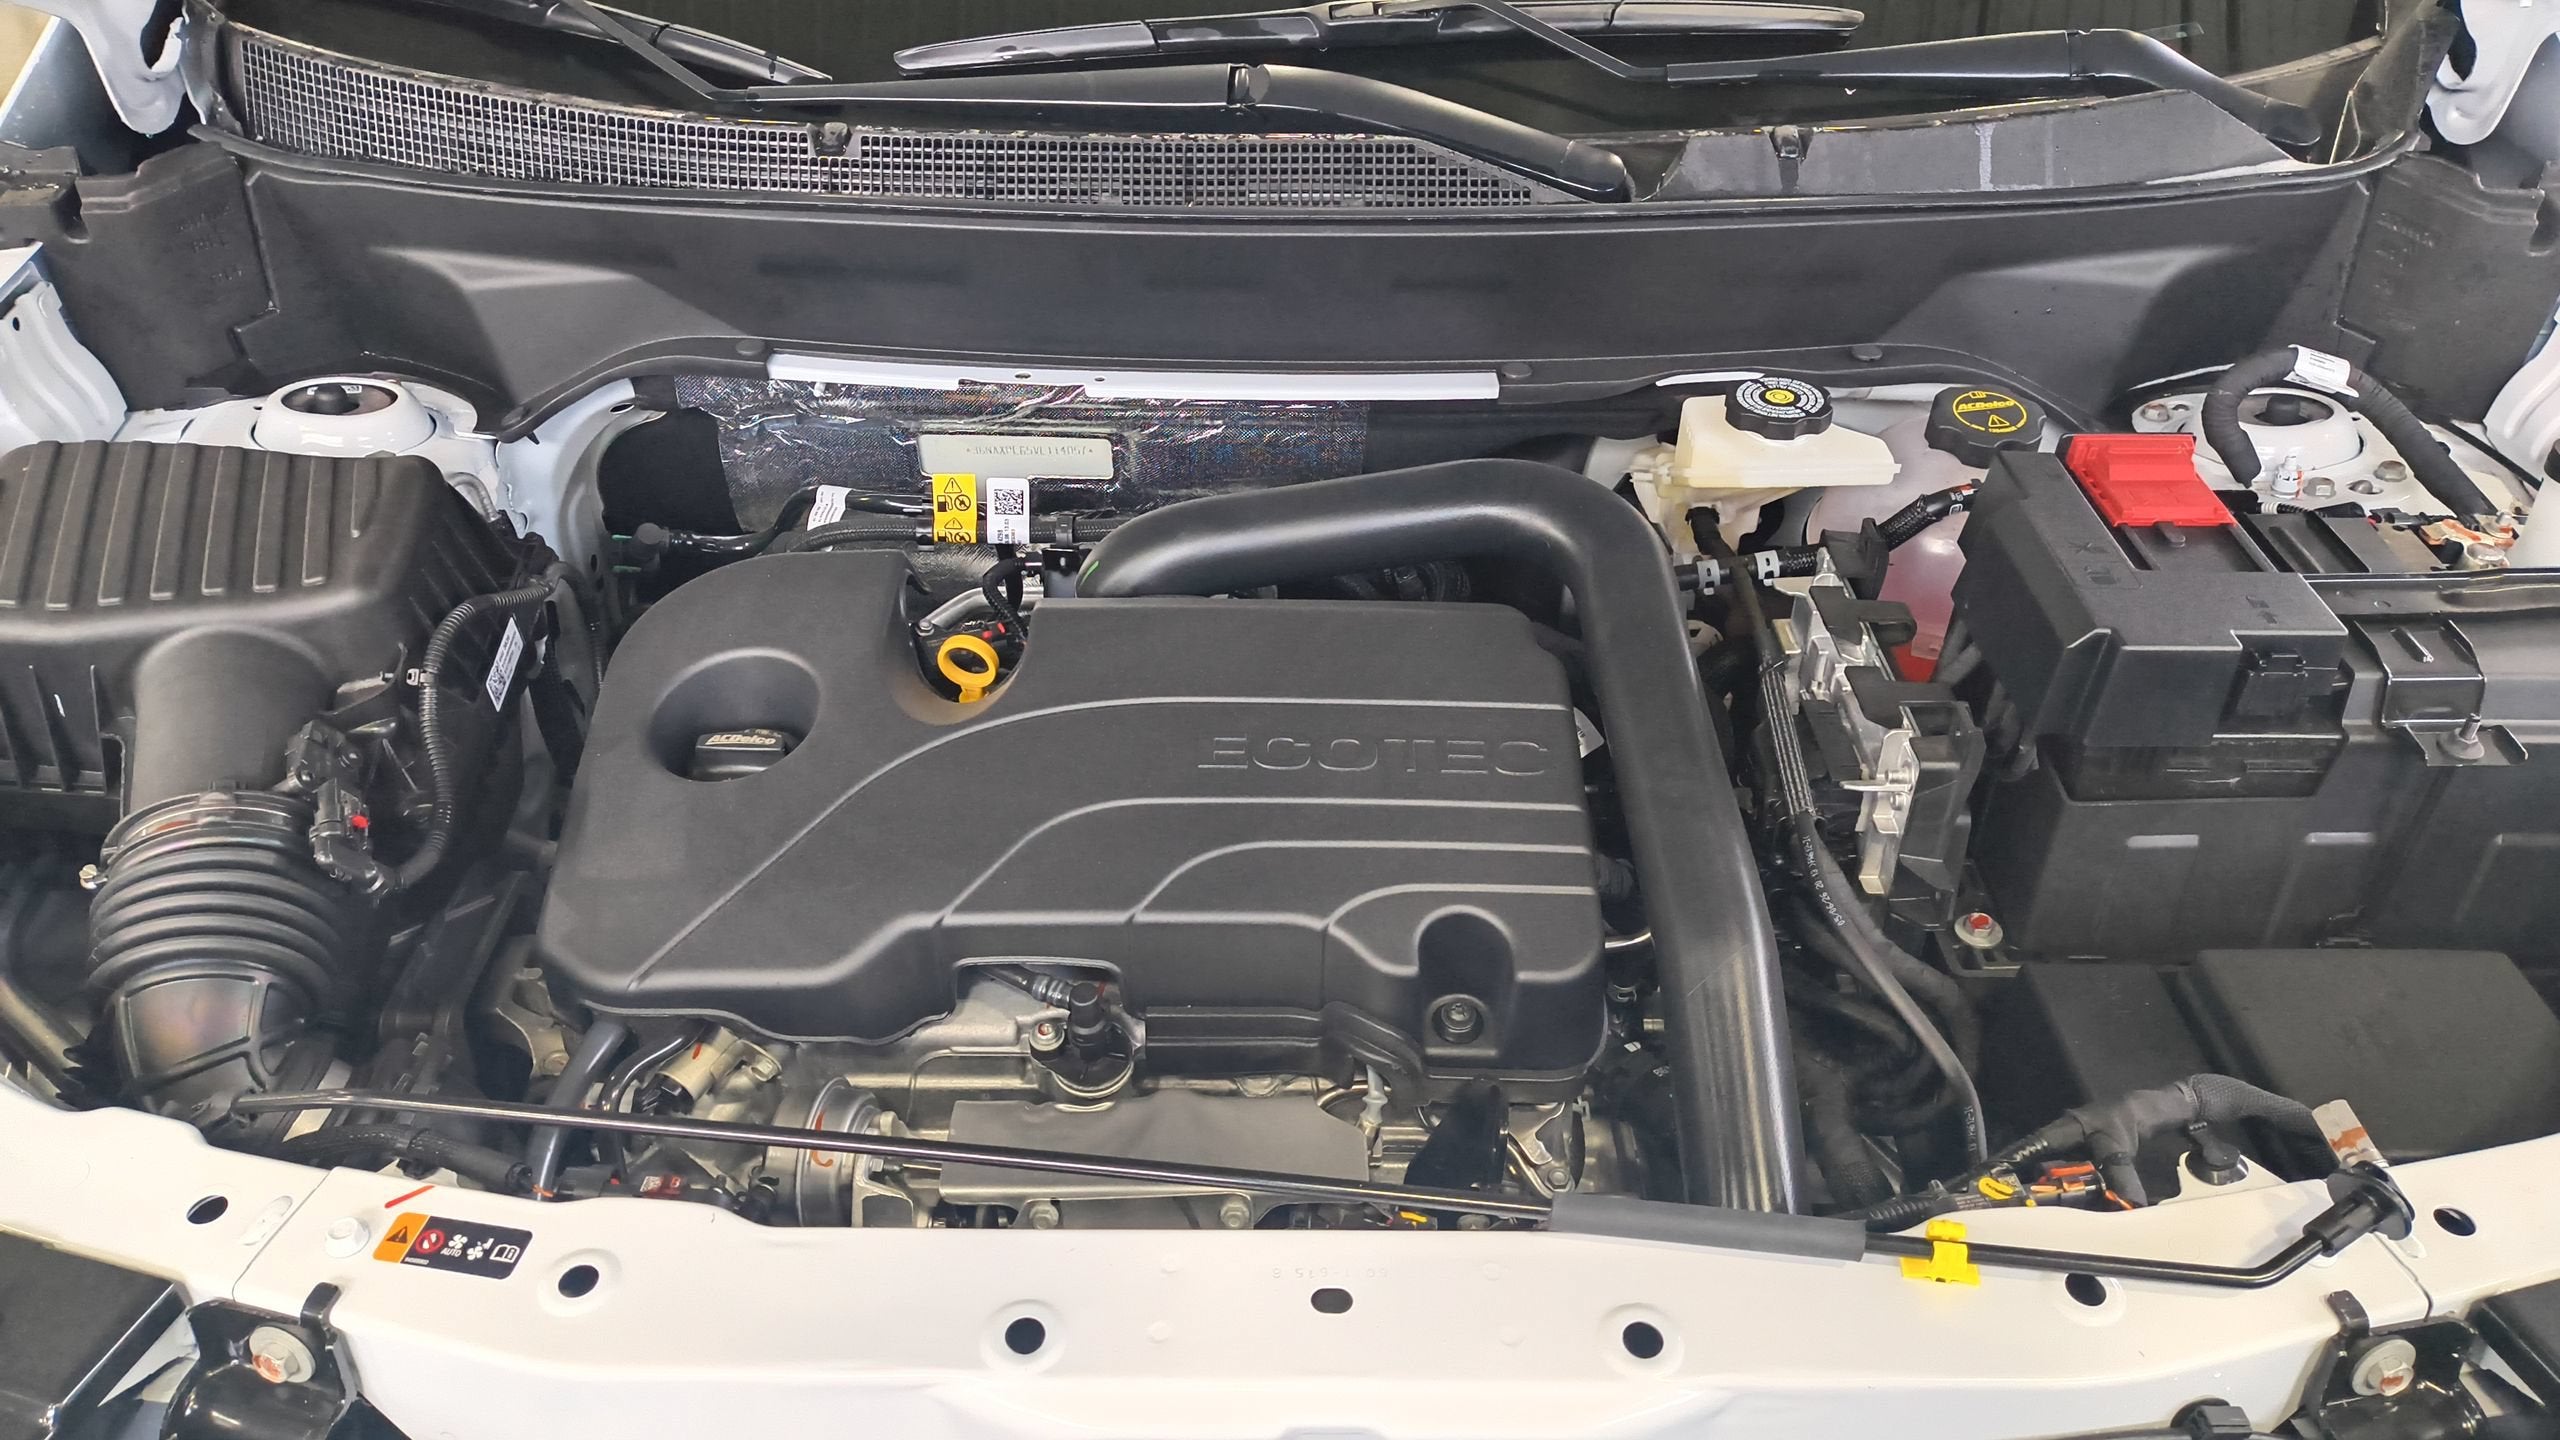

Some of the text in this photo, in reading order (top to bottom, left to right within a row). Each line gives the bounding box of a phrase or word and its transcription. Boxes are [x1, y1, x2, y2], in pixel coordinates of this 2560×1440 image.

[1957, 400, 2016, 413] ACDelco
[704, 734, 777, 745] ACDelco
[1197, 736, 1548, 776] ECOTEC
[440, 1247, 463, 1258] AUTO
